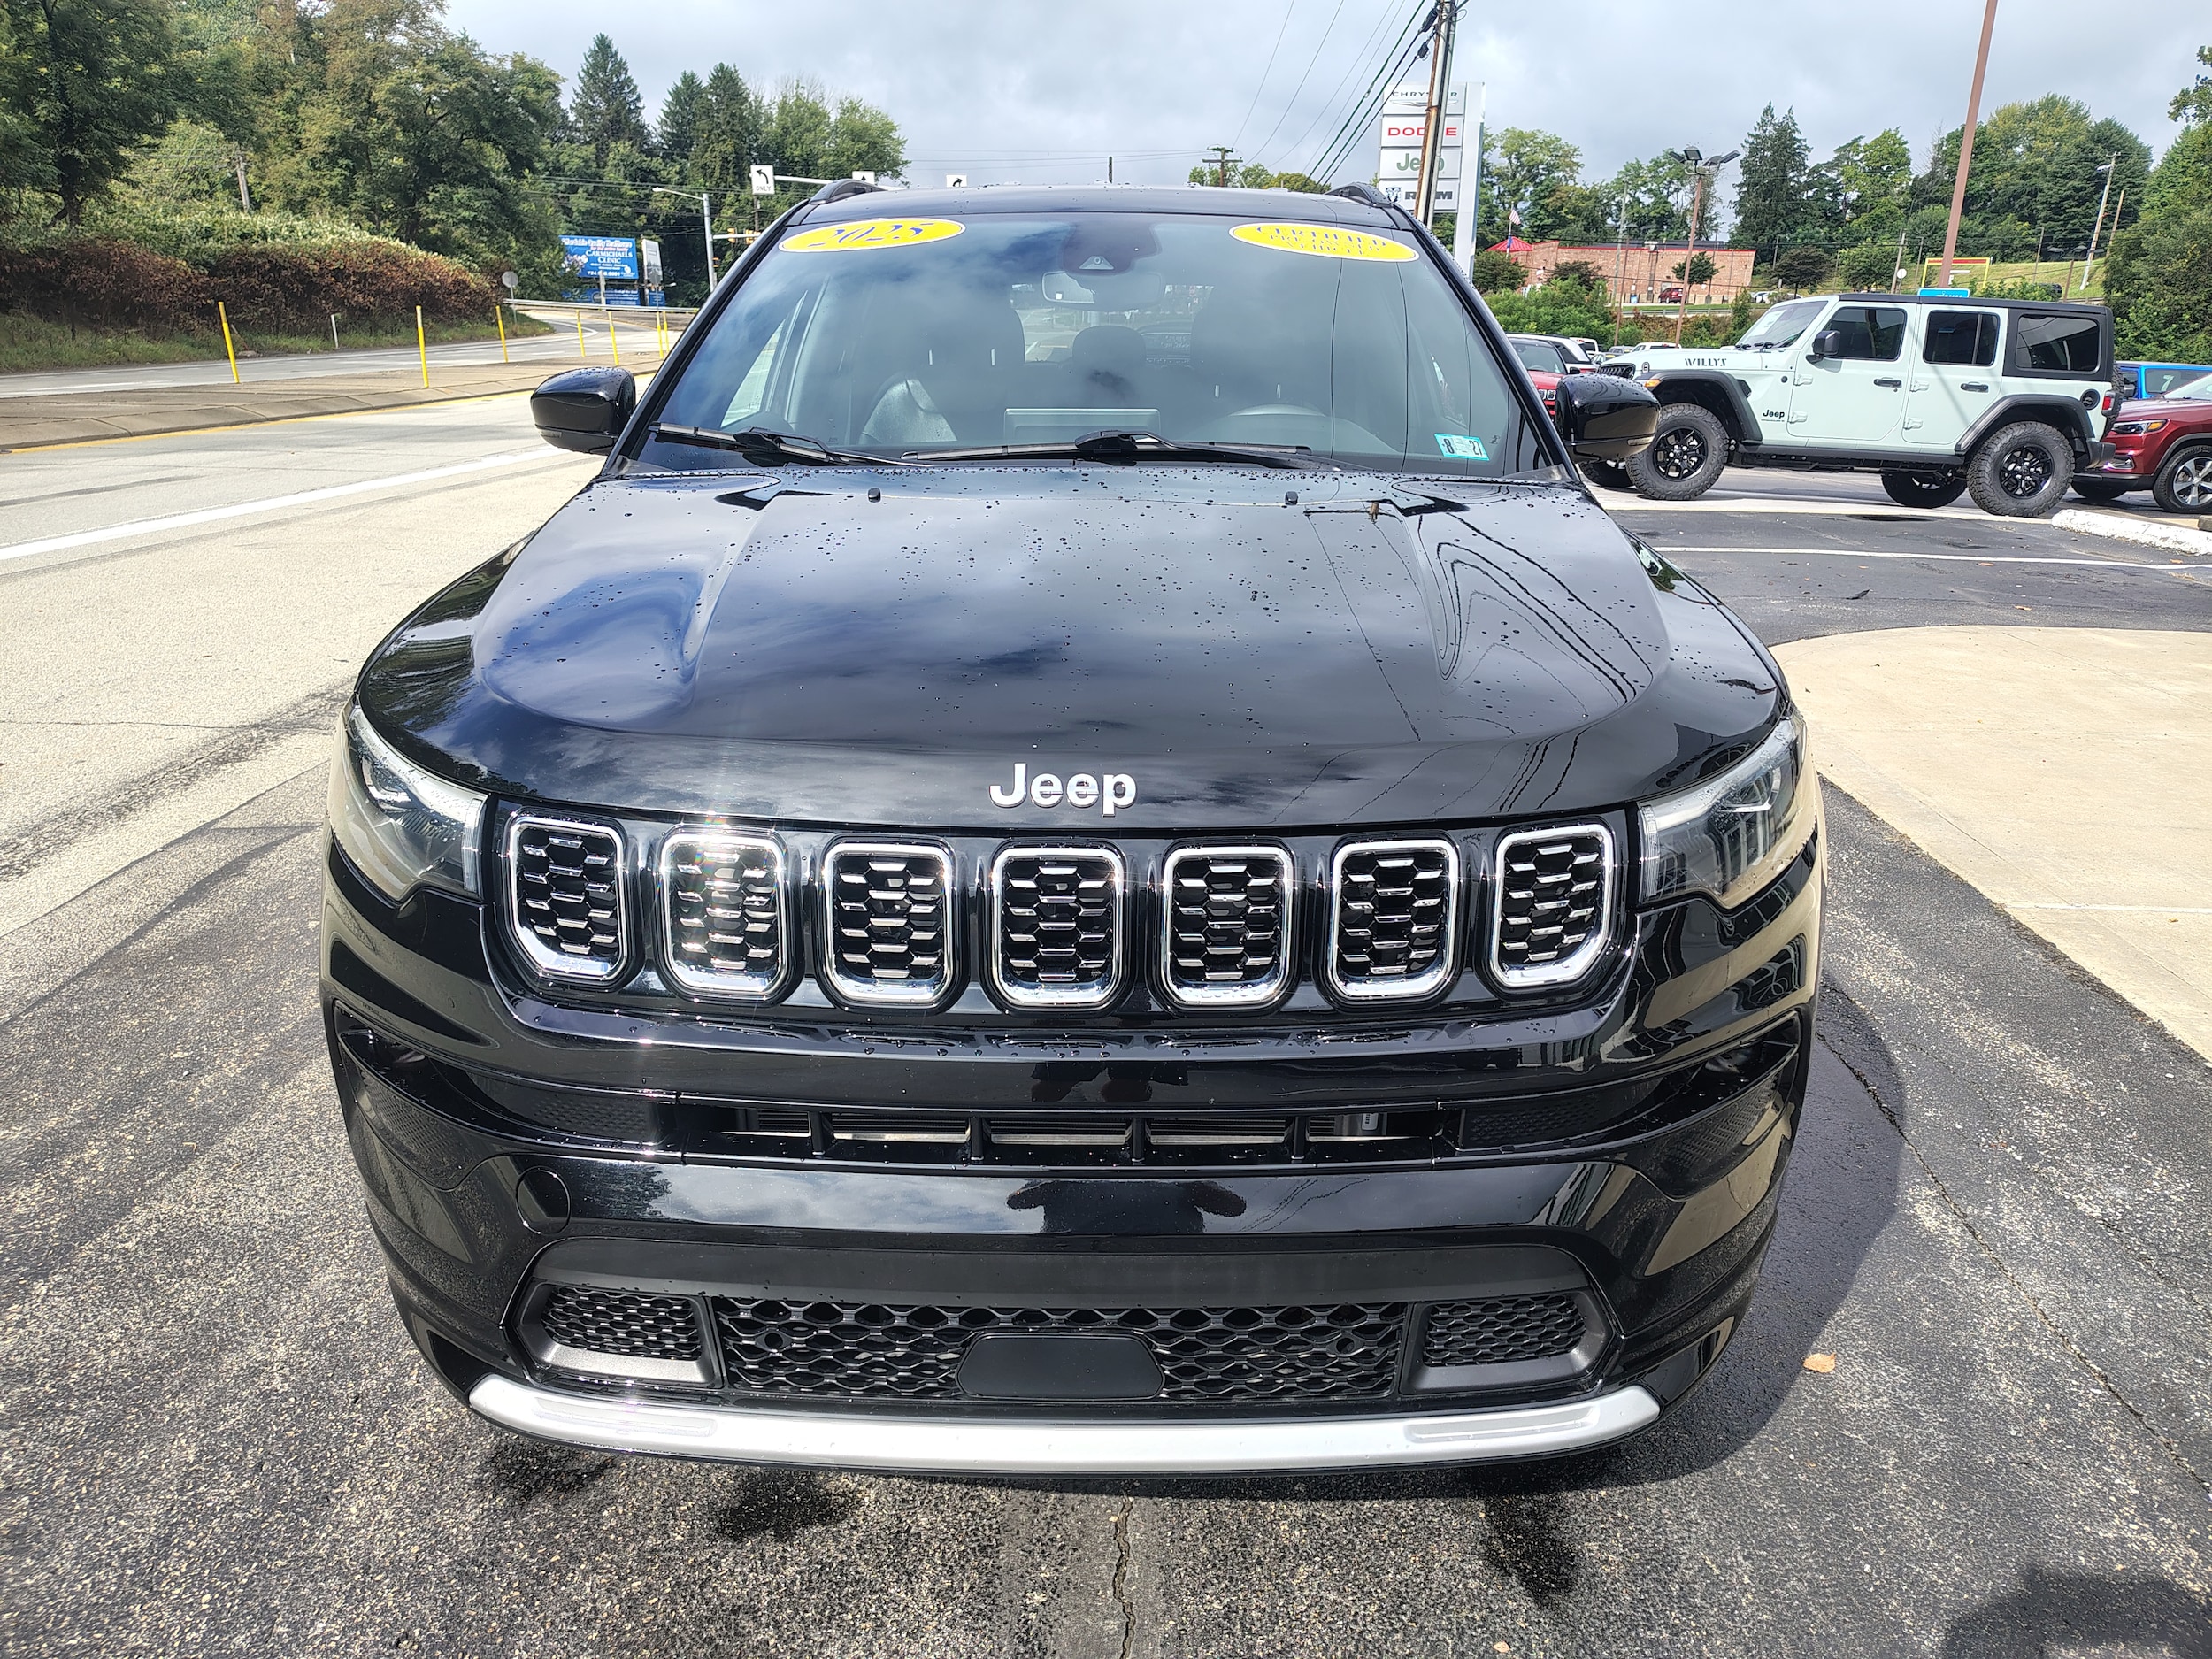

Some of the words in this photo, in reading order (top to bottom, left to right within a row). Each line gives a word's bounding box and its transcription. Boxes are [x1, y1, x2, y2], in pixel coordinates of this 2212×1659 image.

[1388, 127, 1457, 136] DODE
[1404, 191, 1453, 200] RM
[1685, 357, 1727, 367] WILLYS
[1763, 409, 1785, 419] Jeep
[988, 763, 1138, 818] Jeep
